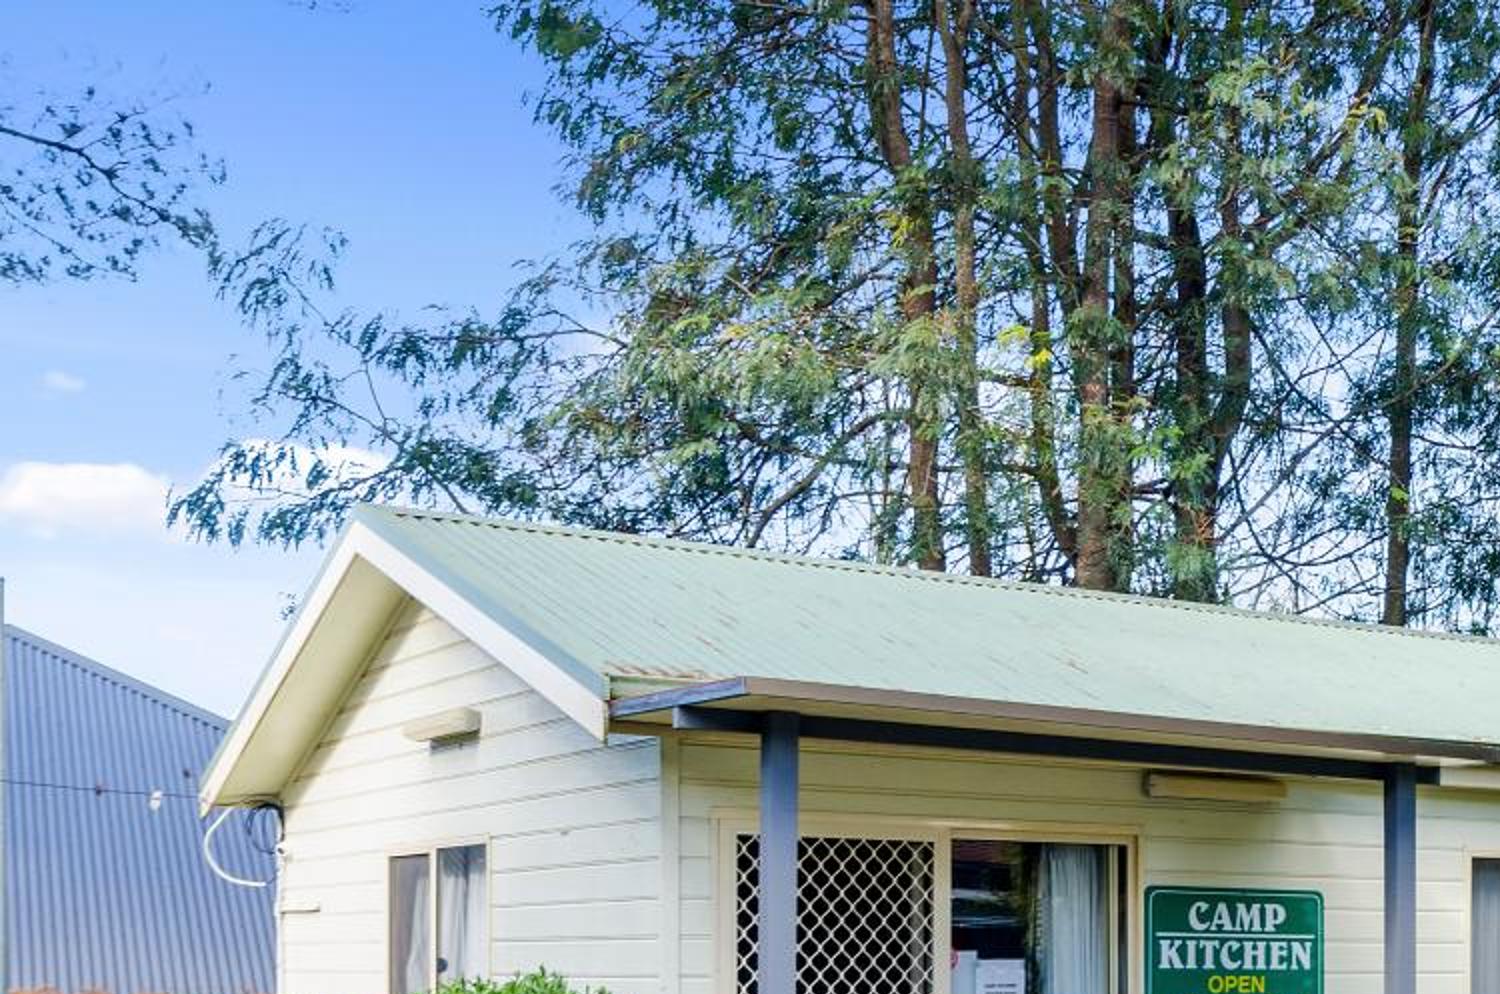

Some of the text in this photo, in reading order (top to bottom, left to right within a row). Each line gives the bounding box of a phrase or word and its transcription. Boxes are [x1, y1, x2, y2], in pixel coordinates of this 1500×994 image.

[1188, 901, 1287, 932] CAMP
[1158, 939, 1313, 971] KITCHEN
[1207, 975, 1266, 994] OPEN
